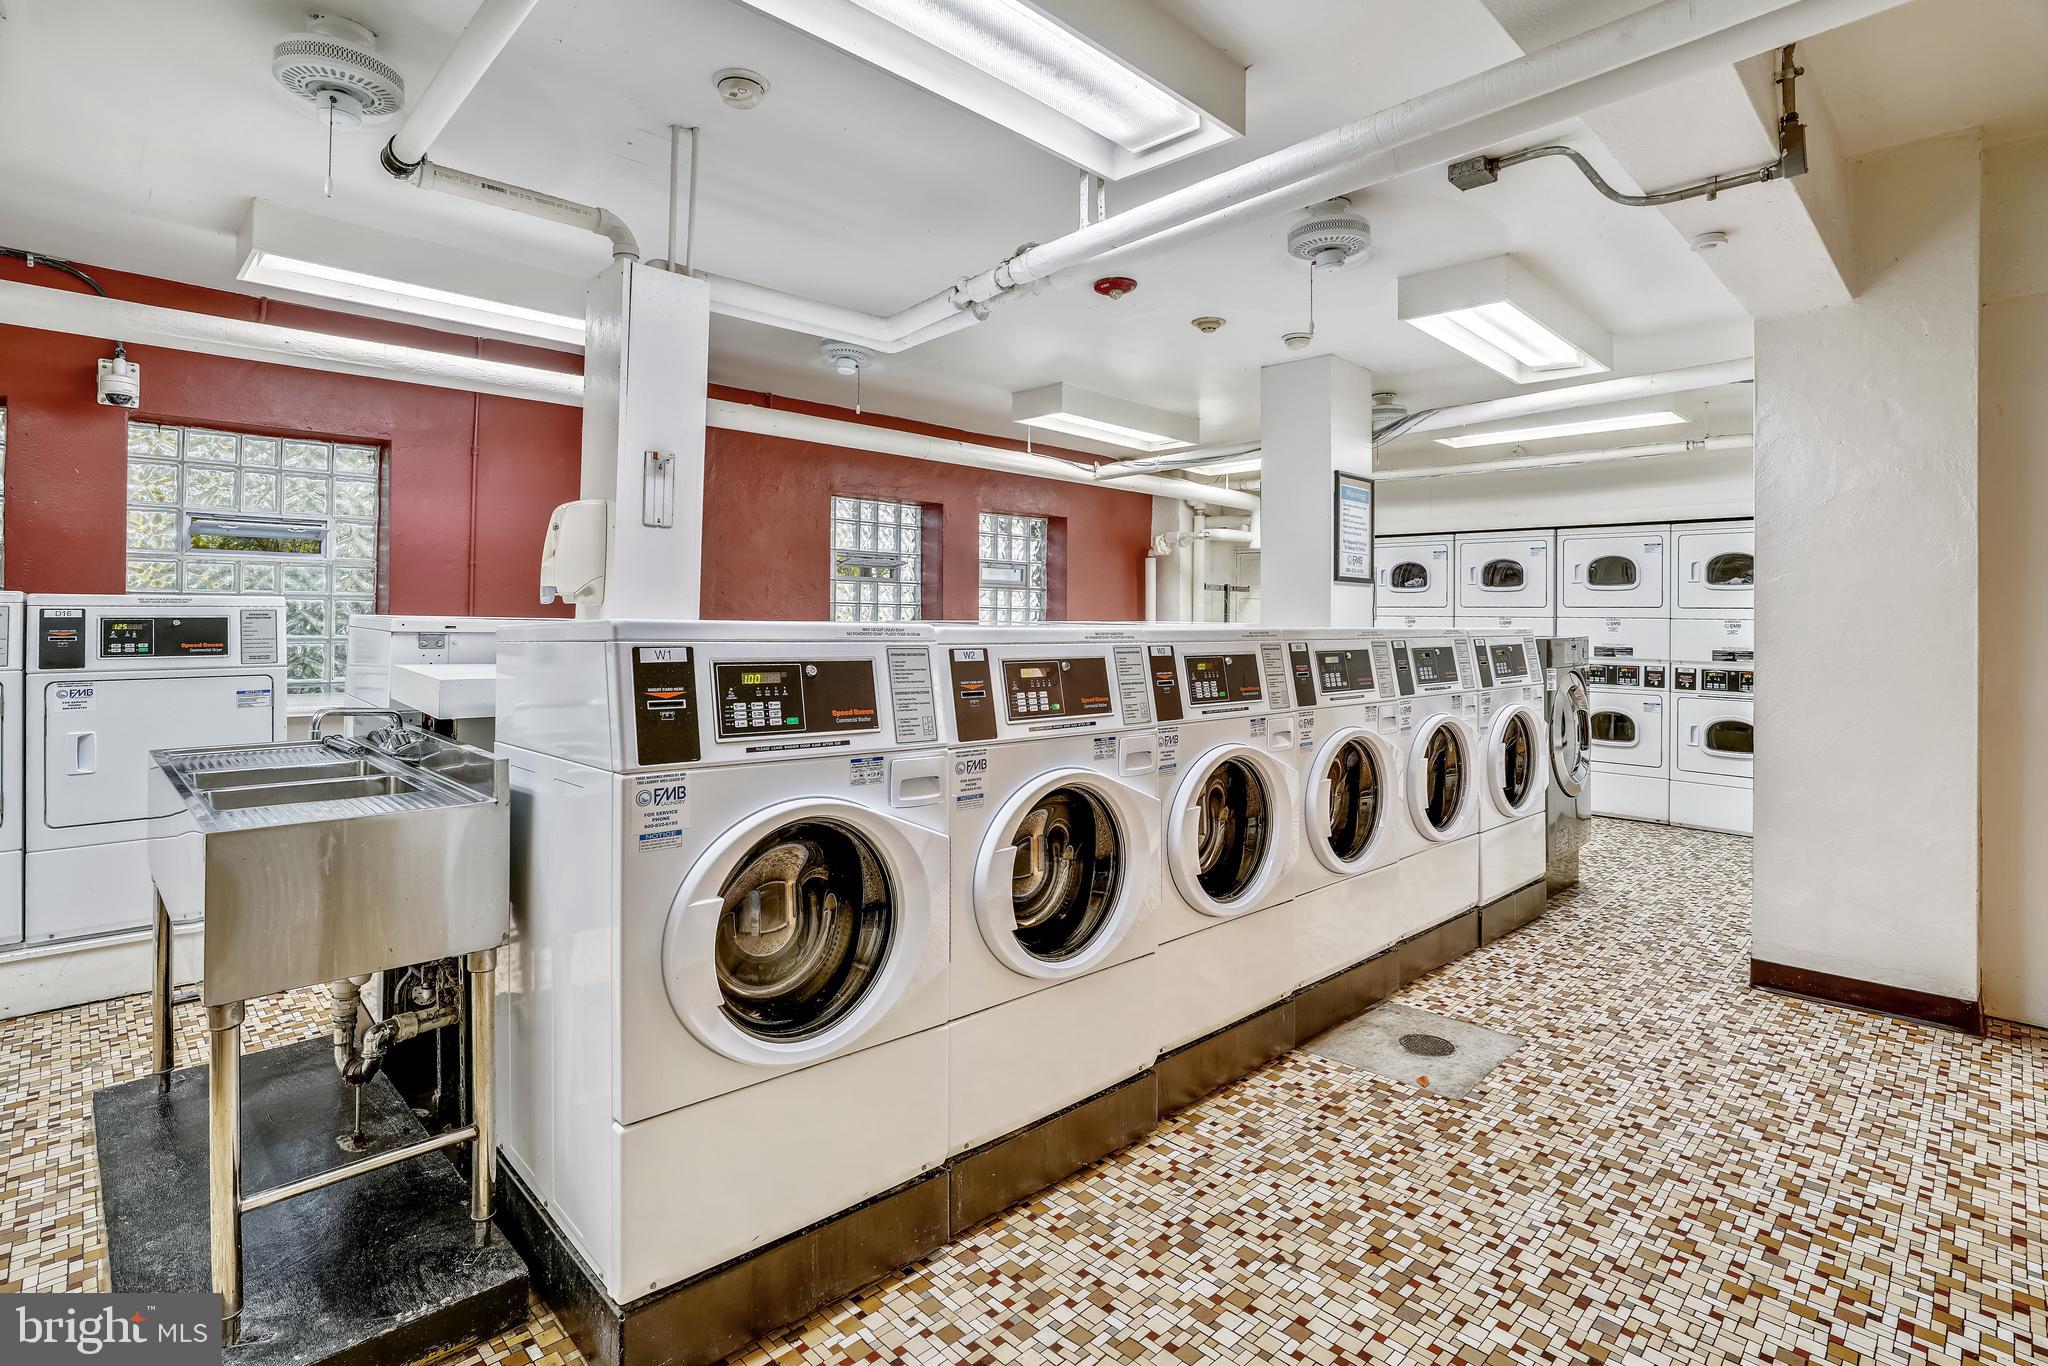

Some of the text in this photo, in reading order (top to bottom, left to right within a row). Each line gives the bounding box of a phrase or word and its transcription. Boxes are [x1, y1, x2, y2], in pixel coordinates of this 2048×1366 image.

[655, 650, 672, 660] W1
[963, 651, 976, 659] W2
[70, 689, 93, 698] FMB
[832, 709, 853, 717] Speed
[1165, 735, 1178, 747] FMB
[967, 759, 987, 774] FMB
[654, 786, 686, 806] FMB
[645, 831, 677, 839] NOTICE
